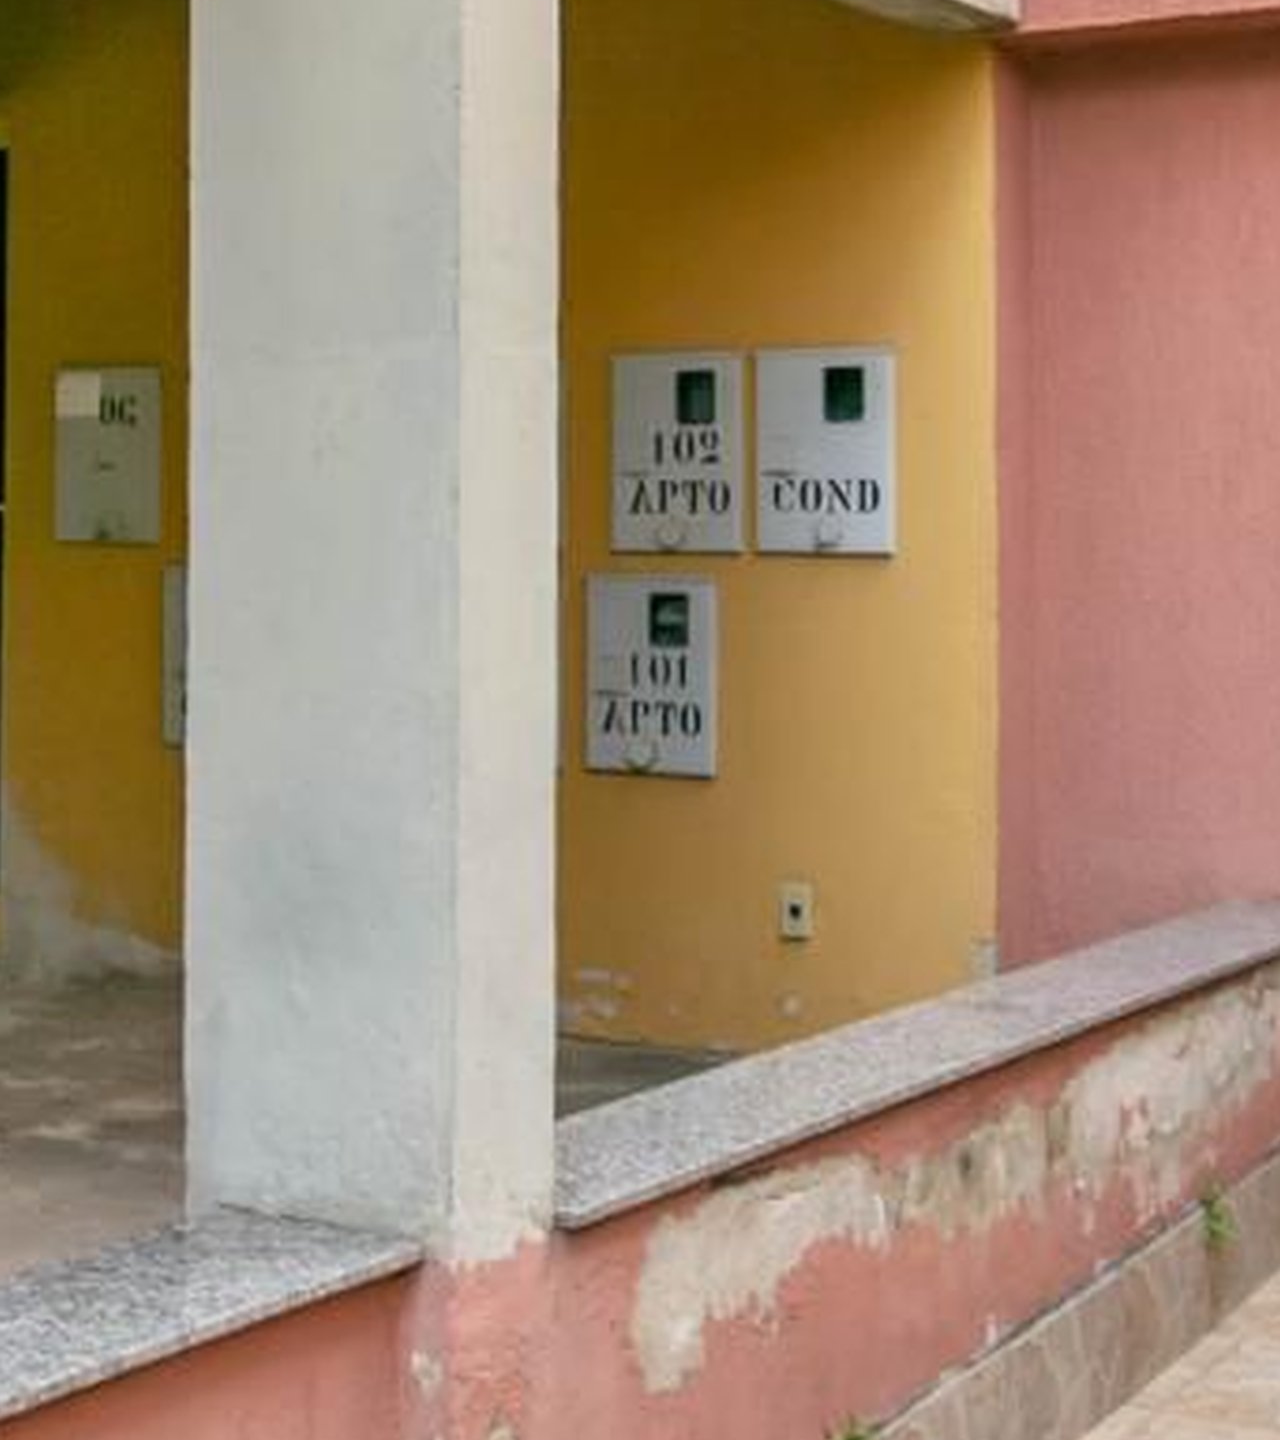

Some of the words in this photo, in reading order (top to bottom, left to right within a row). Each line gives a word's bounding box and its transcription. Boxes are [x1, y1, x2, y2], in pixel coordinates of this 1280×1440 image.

[653, 429, 721, 465] 102
[628, 478, 731, 515] APTO
[772, 478, 881, 514] COND
[630, 653, 687, 688] 101
[601, 699, 702, 737] APTO
